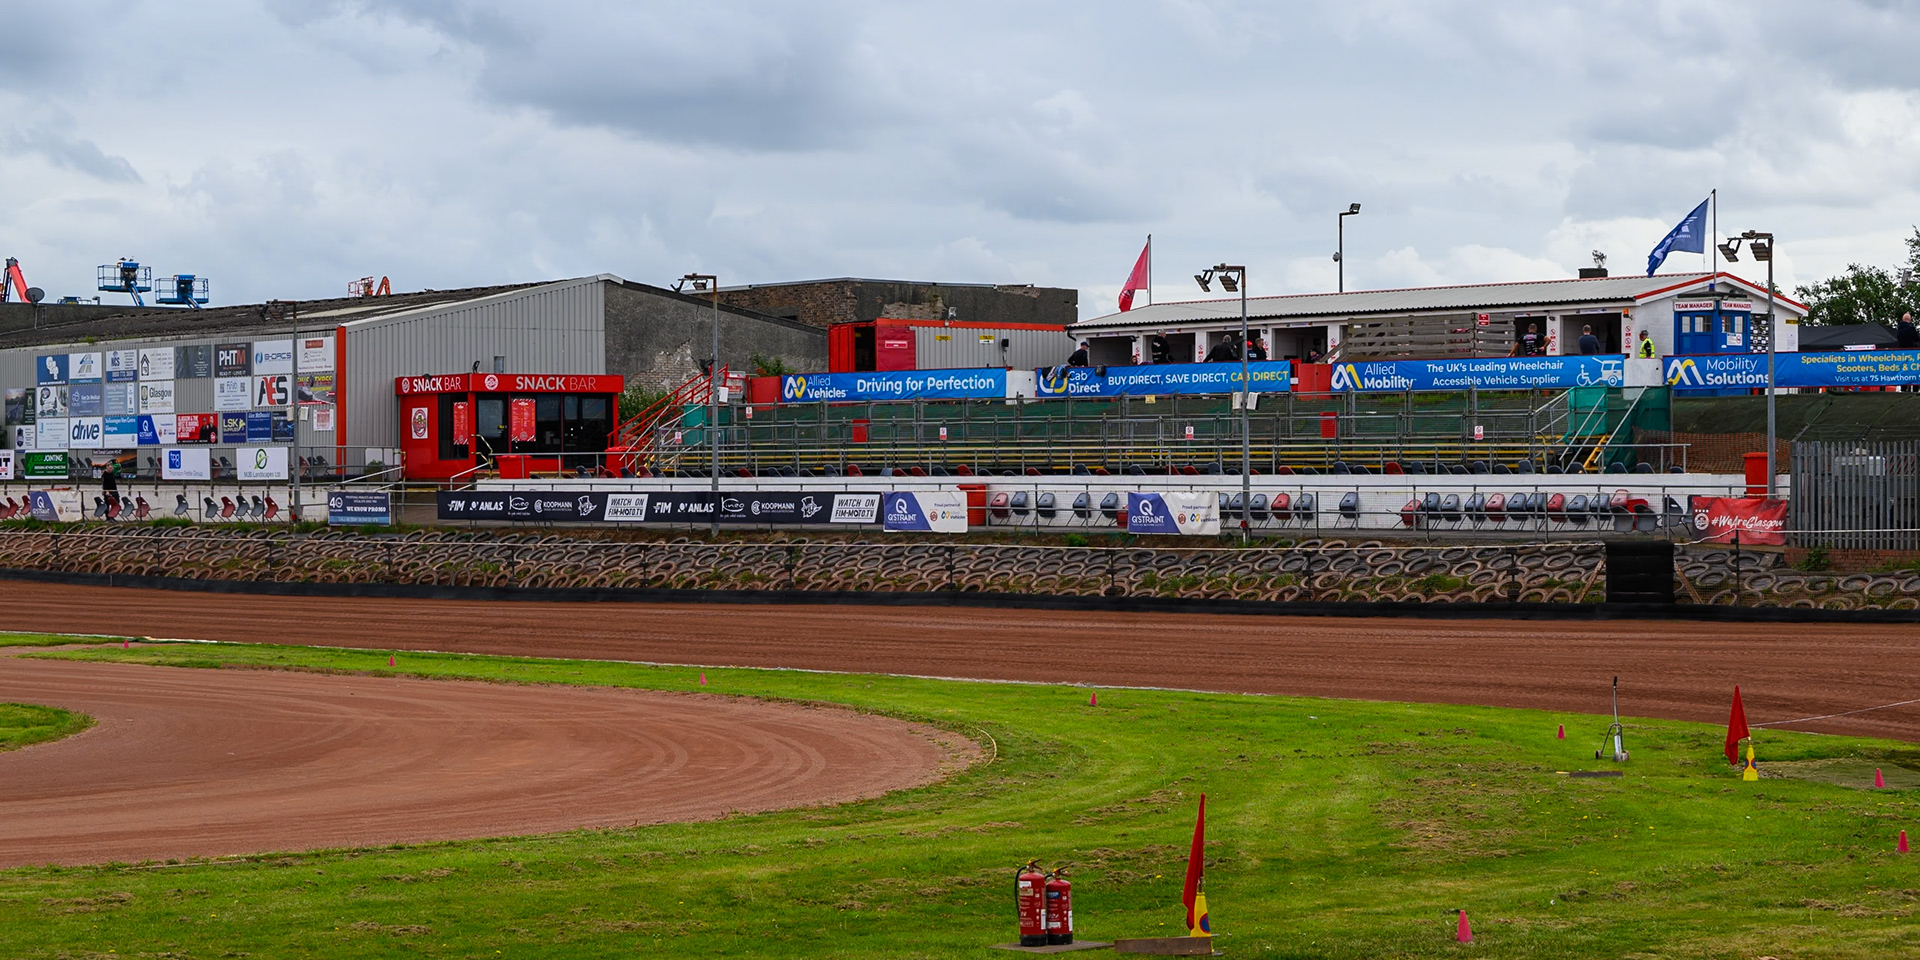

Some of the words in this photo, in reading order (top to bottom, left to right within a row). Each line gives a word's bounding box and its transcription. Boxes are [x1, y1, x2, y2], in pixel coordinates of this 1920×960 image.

[219, 350, 246, 366] PHTM
[1801, 355, 1846, 365] Specialists
[1859, 353, 1914, 362] Wheelchairs,
[1364, 363, 1396, 375] Allied
[1426, 364, 1444, 373] The
[1446, 363, 1467, 372] UK's
[1470, 362, 1506, 373] Leading
[1510, 360, 1564, 371] Wheelchair
[1707, 358, 1758, 372] Mobility
[1837, 364, 1876, 373] Scooters,
[807, 376, 831, 387] Allied
[1068, 370, 1087, 381] Cab
[1108, 376, 1126, 386] BUY
[1128, 375, 1164, 387] DIRECT,
[1165, 374, 1190, 384] SAVE
[1191, 373, 1228, 385] DIRECT,
[1230, 372, 1250, 382] CAB
[1253, 371, 1288, 381] DIRECT
[1433, 376, 1482, 386] Accessible
[1484, 376, 1517, 385] Vehicle
[1520, 375, 1560, 387] Supplier
[1706, 371, 1769, 385] Solutions
[413, 377, 442, 392] SNACK
[444, 376, 461, 391] BAR
[516, 376, 566, 390] SNACK
[570, 377, 596, 390] BAR
[857, 379, 902, 395] Driving
[906, 378, 923, 390] for
[927, 376, 994, 392] Perfection
[1068, 382, 1101, 394] Direct
[1364, 376, 1414, 390] Mobility
[149, 387, 172, 400] Glasgow
[258, 376, 288, 406] AES
[807, 388, 846, 399] Vehicles
[223, 418, 239, 428] LSK
[72, 420, 100, 441] drive
[448, 500, 465, 511] FIM
[479, 501, 504, 511] ANLAS
[611, 498, 631, 506] WATCH
[653, 502, 672, 513] FIM
[688, 503, 715, 513] ANLAS
[838, 498, 861, 507] WATCH
[865, 498, 876, 507] ON
[835, 510, 874, 518] FIM-MOTO.TV
[1712, 516, 1784, 529] #WeAreGlasgow
